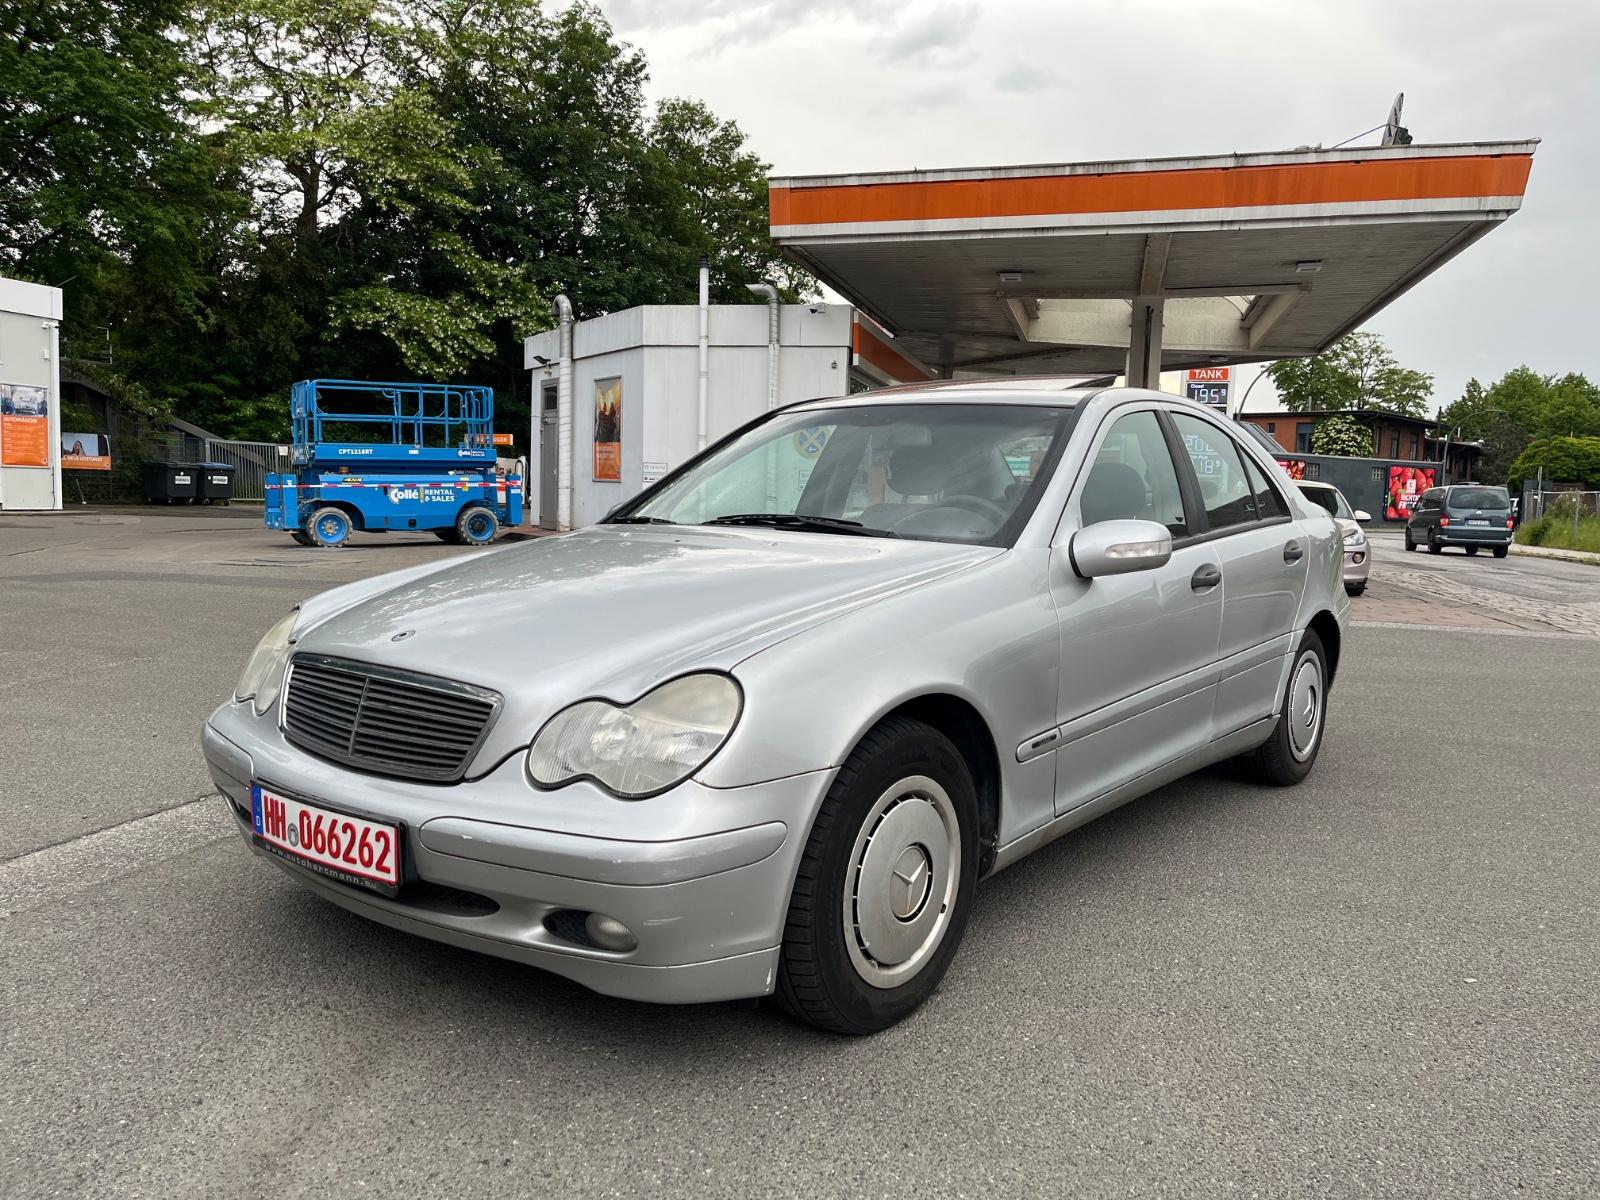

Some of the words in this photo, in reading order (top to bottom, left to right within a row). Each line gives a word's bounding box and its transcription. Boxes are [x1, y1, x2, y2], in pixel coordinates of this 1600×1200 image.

[1194, 370, 1223, 379] TANK
[390, 488, 419, 503] Collé
[256, 815, 260, 826] D
[264, 795, 286, 841] HH
[299, 809, 391, 874] 066262
